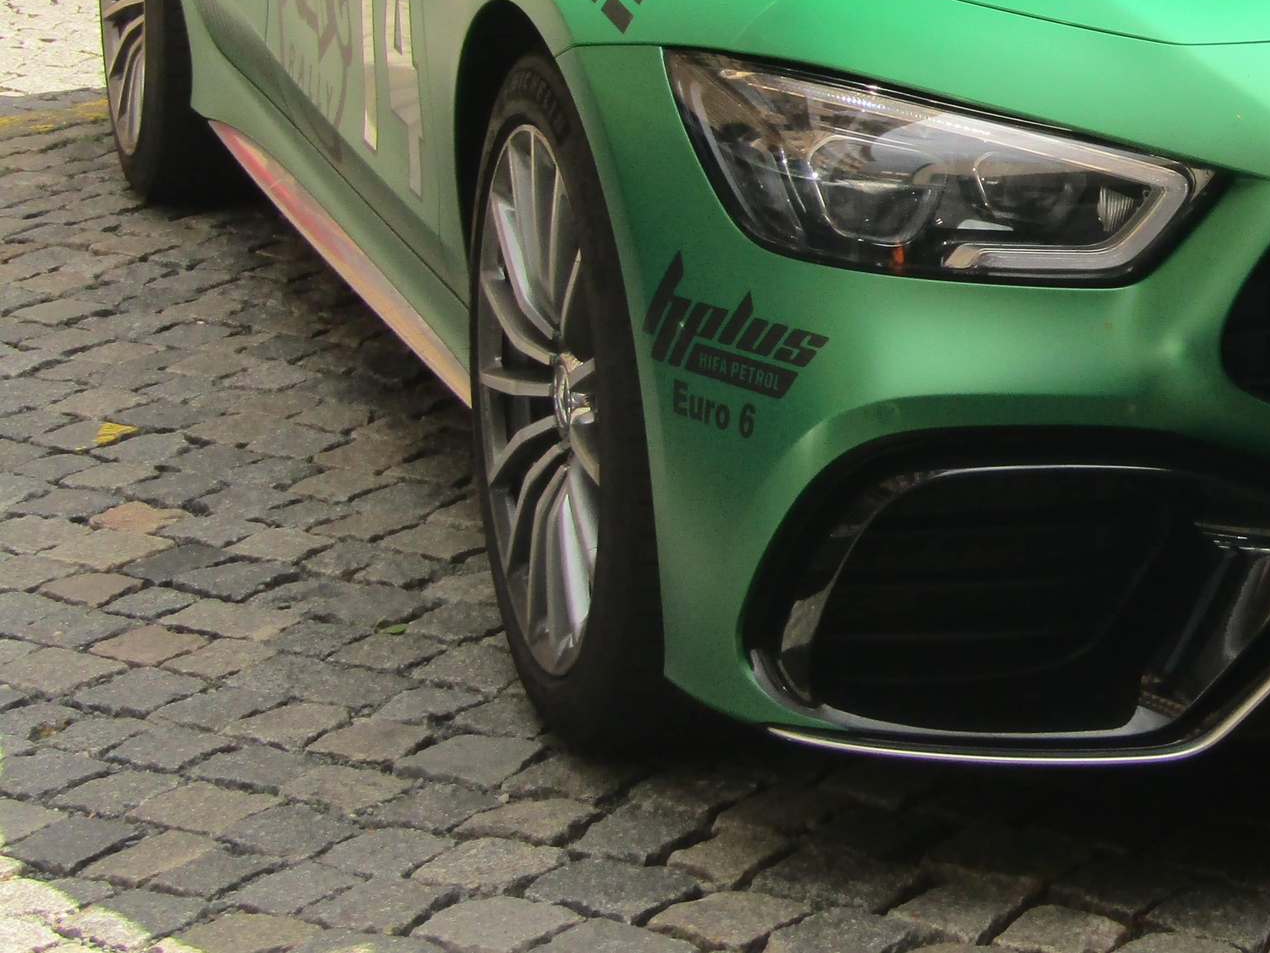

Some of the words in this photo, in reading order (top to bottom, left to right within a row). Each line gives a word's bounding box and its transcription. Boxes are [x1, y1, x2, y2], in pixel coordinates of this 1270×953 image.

[699, 351, 727, 374] HIFA
[731, 359, 780, 391] PETROL
[673, 379, 730, 430] Euro
[739, 402, 756, 439] 6
